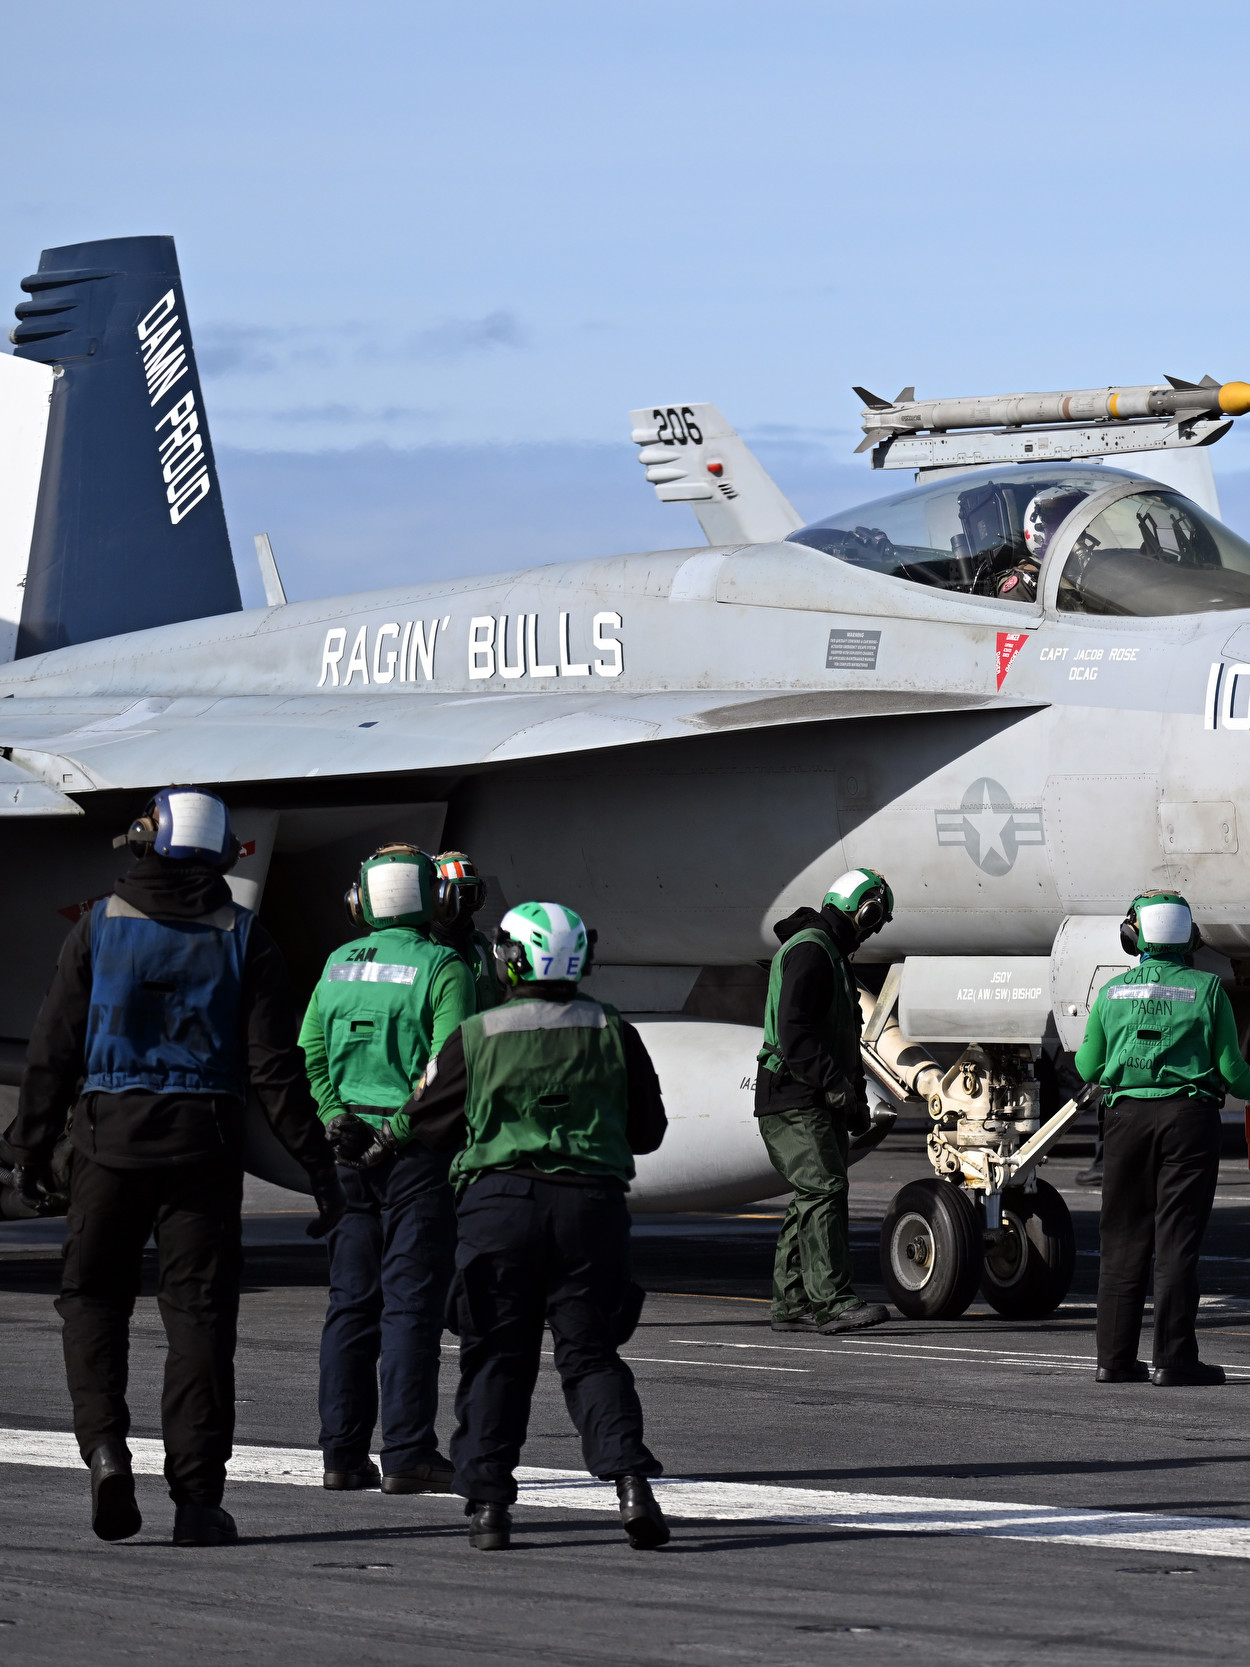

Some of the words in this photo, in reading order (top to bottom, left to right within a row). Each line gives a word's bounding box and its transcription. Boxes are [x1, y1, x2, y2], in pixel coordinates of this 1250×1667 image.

[137, 288, 189, 408] DAMN
[653, 407, 703, 446] 206
[154, 390, 211, 525] PROUD
[316, 616, 451, 688] RAGIN'
[468, 611, 625, 680] BULLS
[1039, 647, 1069, 661] CAPT
[1073, 649, 1104, 661] JACOB
[1108, 648, 1140, 661] ROSE
[1068, 667, 1098, 681] DCAG
[541, 957, 554, 976] 7
[566, 957, 580, 976] E
[1124, 965, 1163, 984] CATS
[1012, 988, 1042, 1000] BISHOP
[1131, 1000, 1173, 1016] PAGAN
